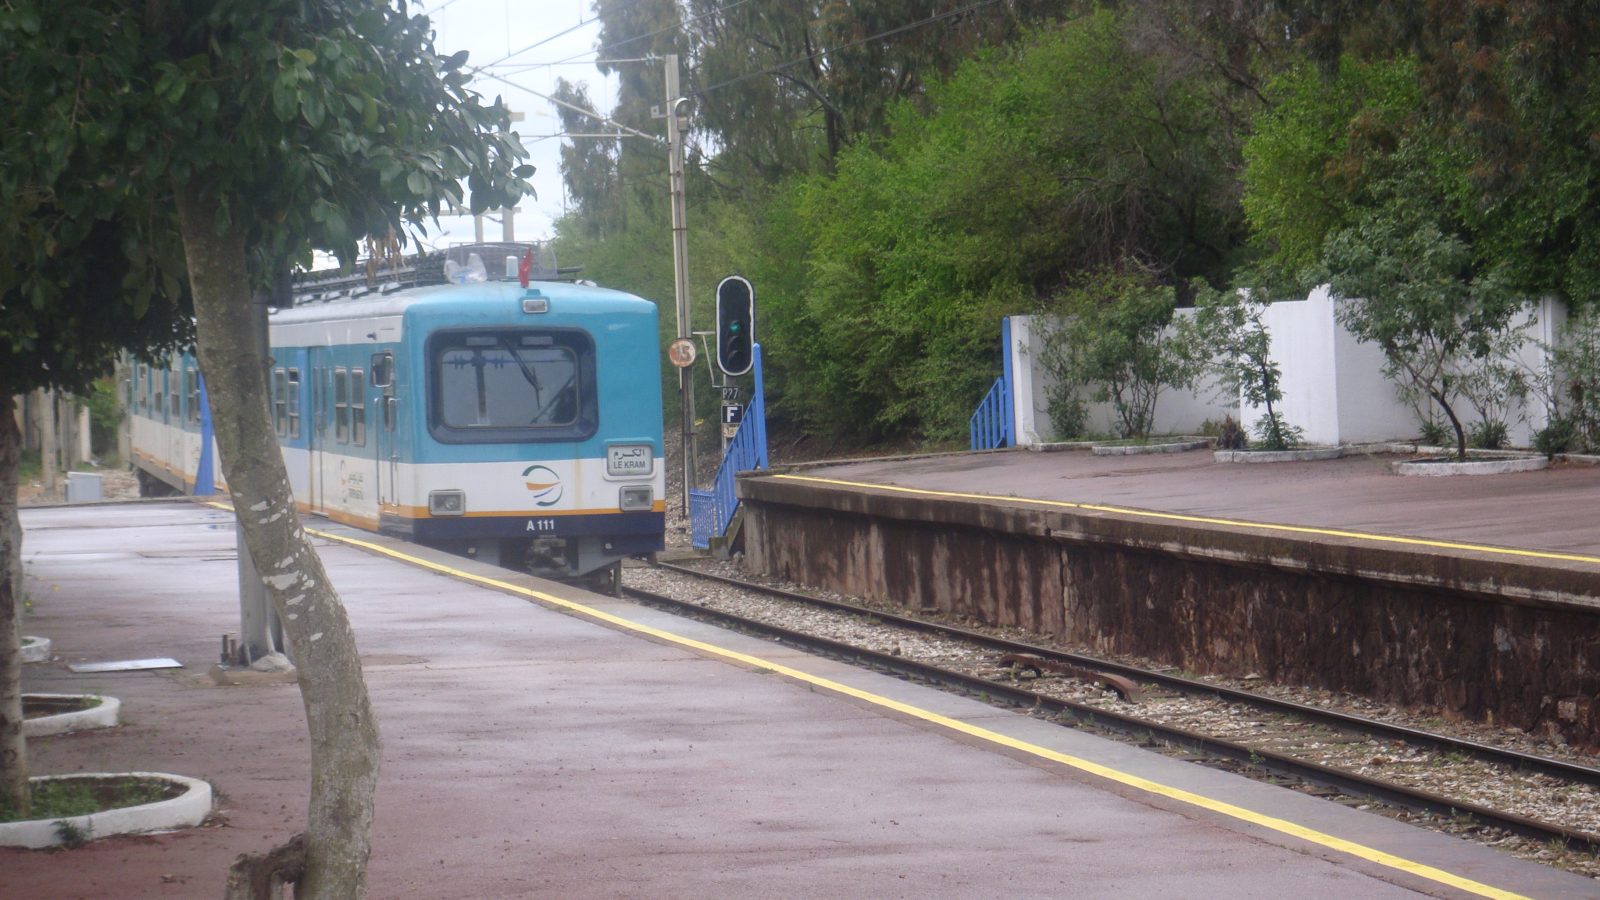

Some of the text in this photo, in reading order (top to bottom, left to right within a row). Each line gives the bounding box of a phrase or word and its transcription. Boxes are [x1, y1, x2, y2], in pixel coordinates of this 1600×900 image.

[727, 407, 738, 422] F
[614, 460, 645, 469] LE KRAM
[526, 520, 554, 531] A 111
